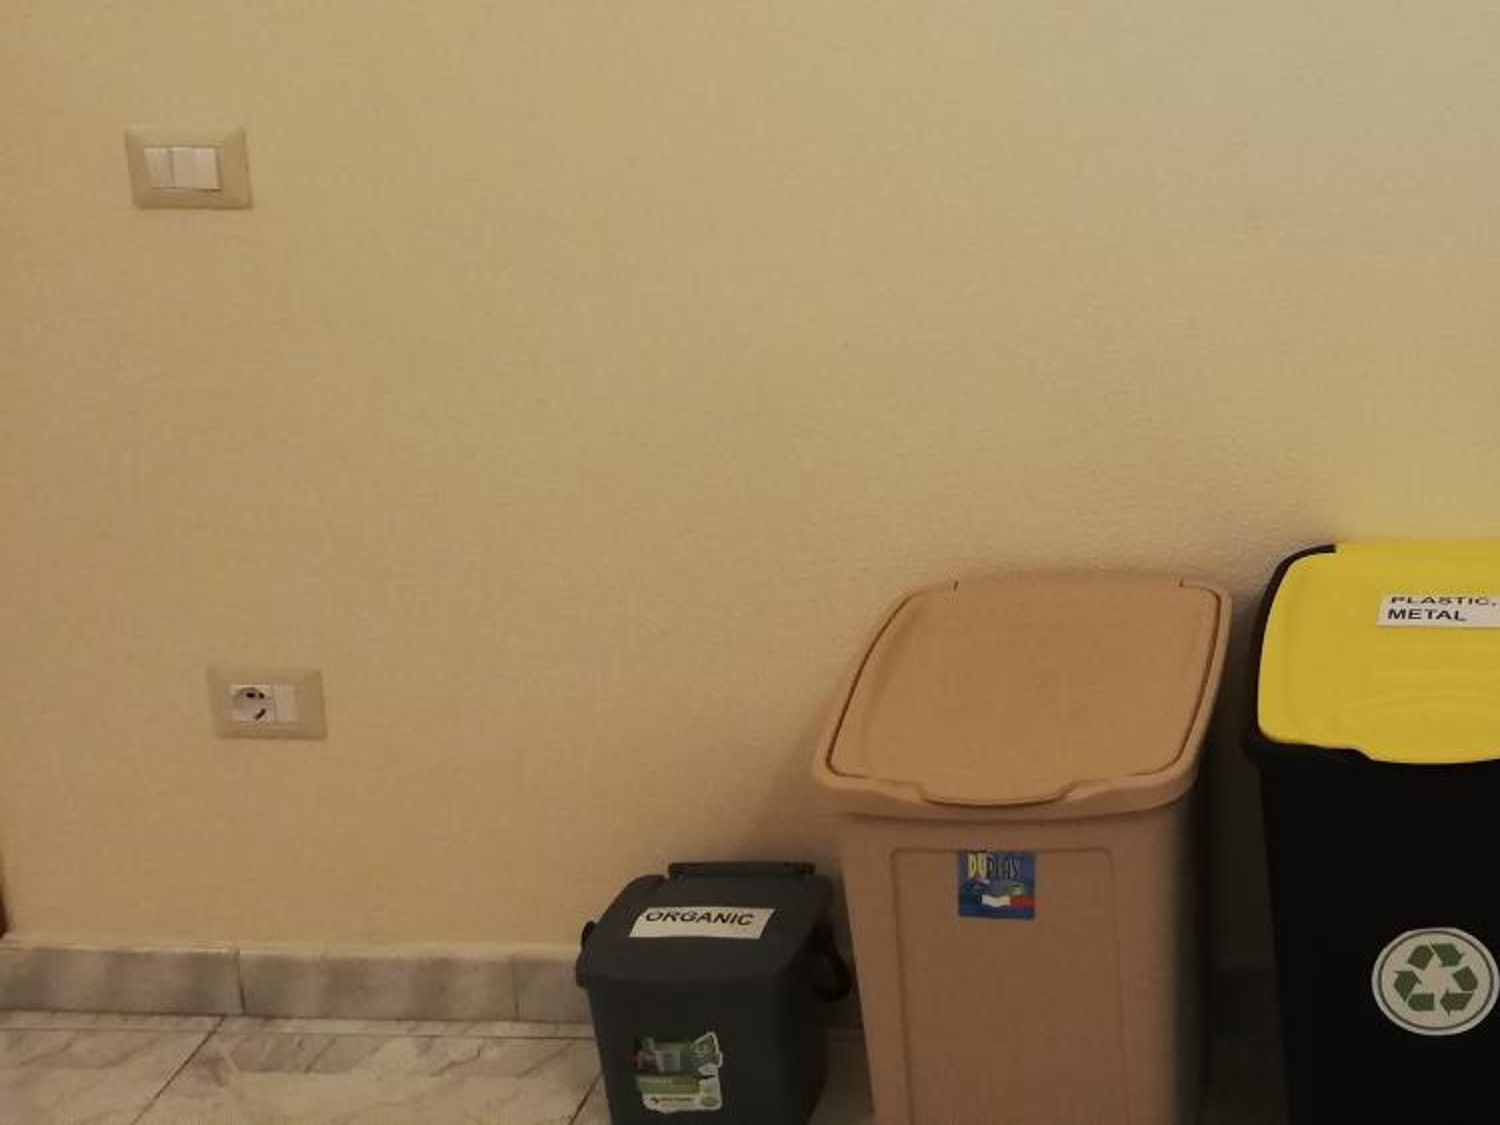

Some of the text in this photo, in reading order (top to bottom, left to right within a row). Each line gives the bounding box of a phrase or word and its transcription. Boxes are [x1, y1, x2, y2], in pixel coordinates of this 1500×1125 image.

[1391, 596, 1497, 606] PLASTIC,
[1388, 608, 1467, 621] METAL
[646, 910, 754, 926] ORGANIC
